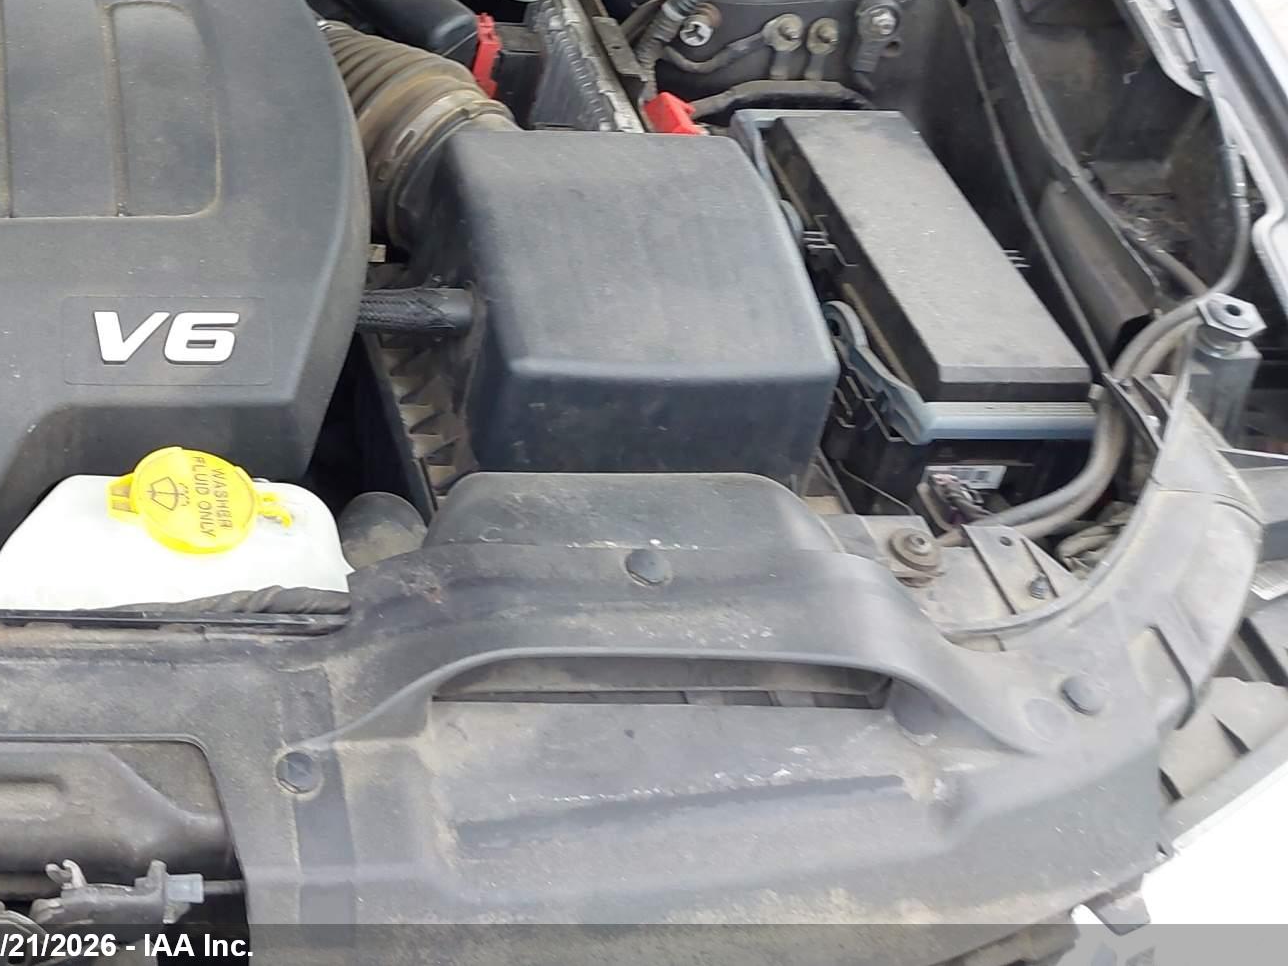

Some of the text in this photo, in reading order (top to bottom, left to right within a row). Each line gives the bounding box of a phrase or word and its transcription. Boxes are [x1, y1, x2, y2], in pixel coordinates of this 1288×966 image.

[94, 311, 240, 364] V6
[192, 456, 216, 538] FLUID ONLY
[211, 467, 233, 529] WASHER
